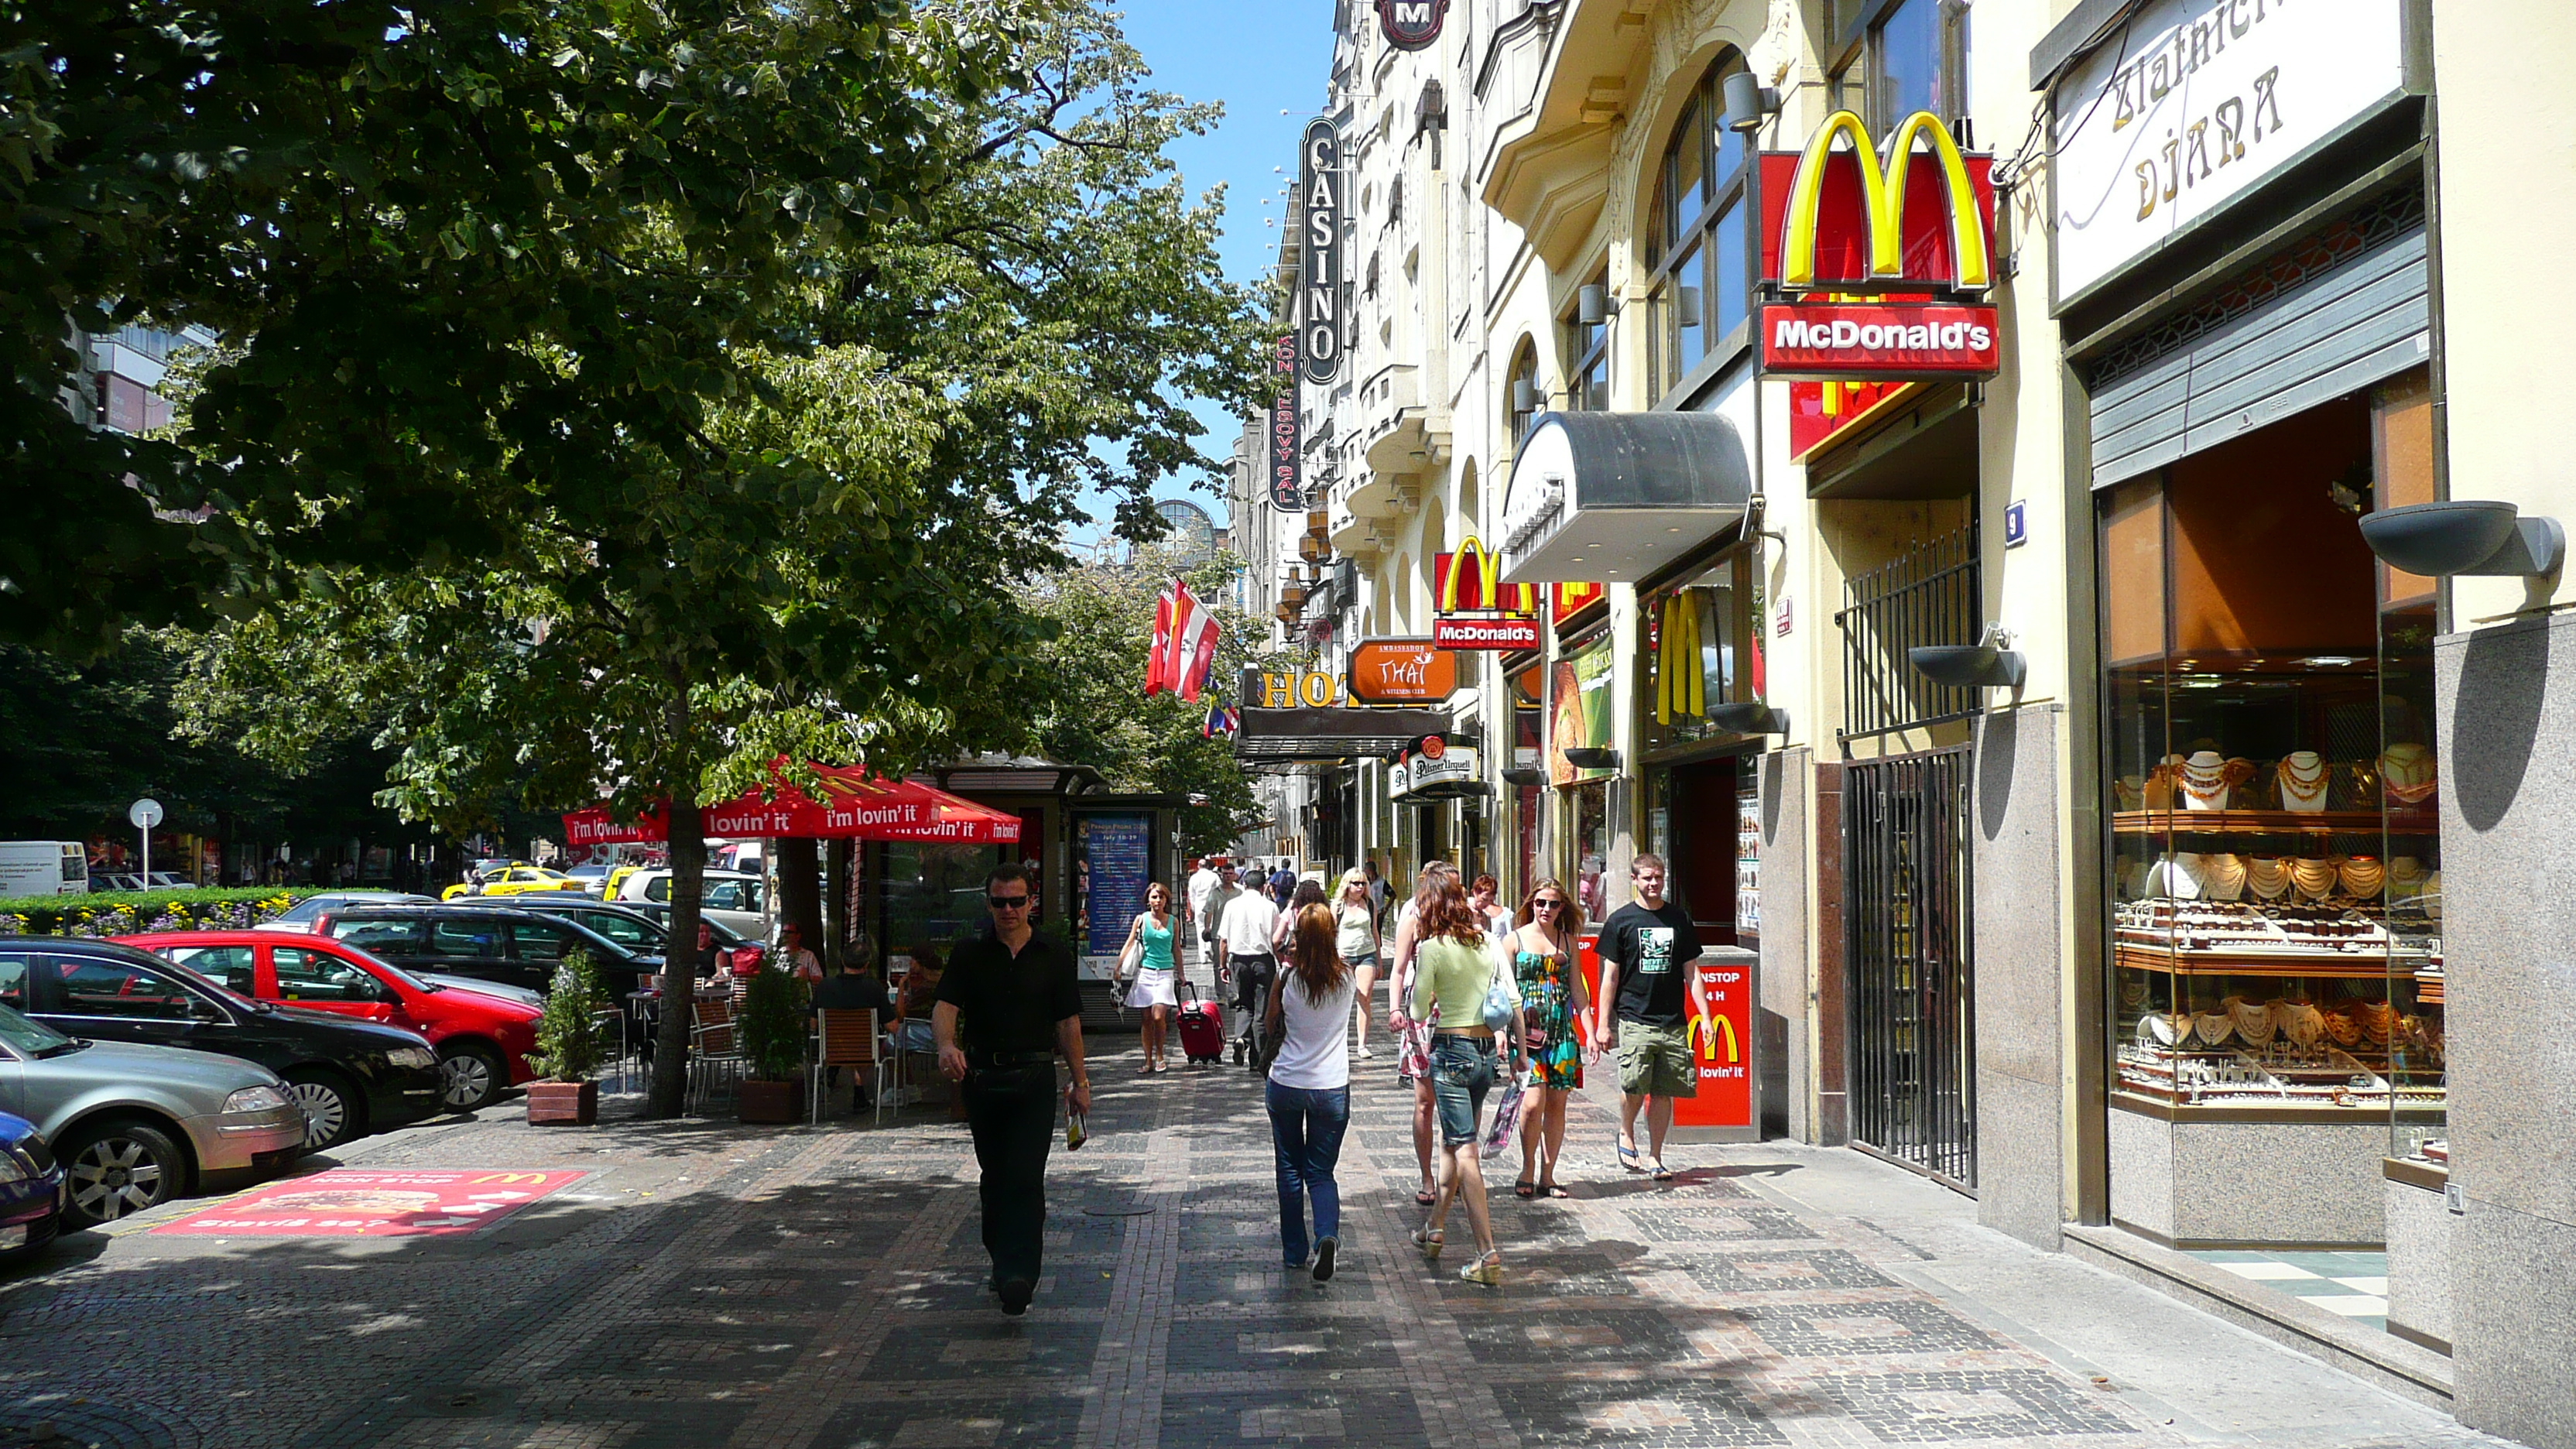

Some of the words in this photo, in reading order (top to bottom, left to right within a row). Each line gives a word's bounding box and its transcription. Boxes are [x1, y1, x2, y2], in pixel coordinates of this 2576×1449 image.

[1309, 137, 1334, 361] CASINO
[1775, 320, 1991, 350] McDonald's
[2009, 512, 2016, 536] 9
[1439, 626, 1535, 641] McDonald's
[1377, 659, 1426, 686] THAI
[1416, 759, 1445, 779] Pilsner
[1444, 759, 1471, 773] Urquell
[710, 813, 769, 833] lovin'
[827, 810, 852, 828] i'm
[857, 804, 902, 825] lovin'
[574, 820, 591, 838] i'm
[963, 821, 975, 837] it
[1715, 991, 1725, 1001] H
[1700, 1067, 1733, 1078] lovin'
